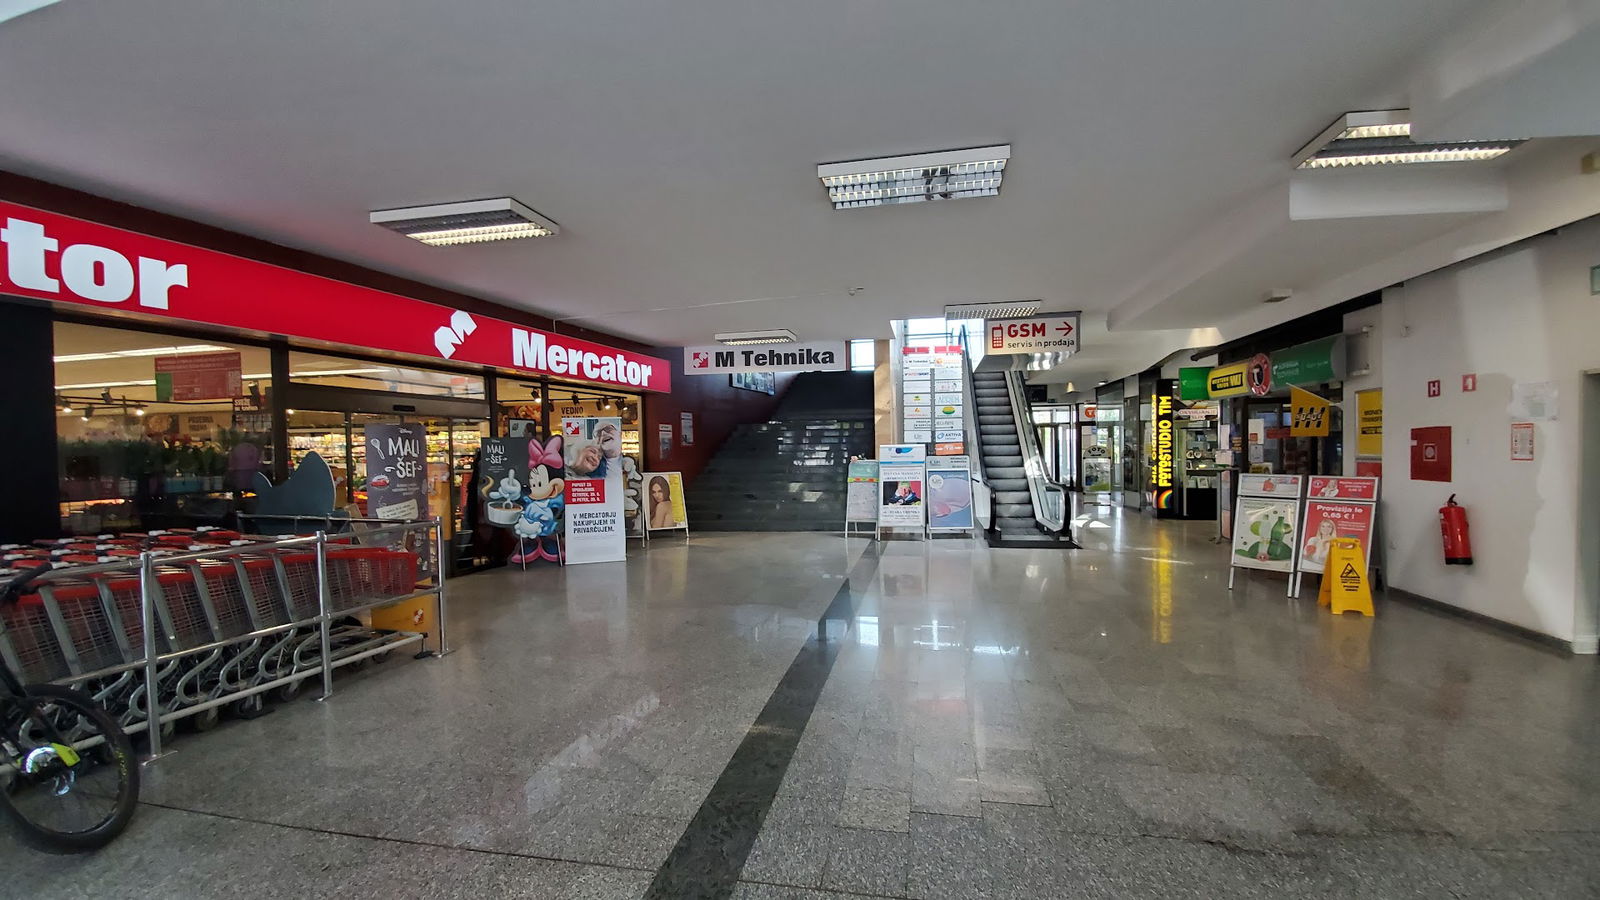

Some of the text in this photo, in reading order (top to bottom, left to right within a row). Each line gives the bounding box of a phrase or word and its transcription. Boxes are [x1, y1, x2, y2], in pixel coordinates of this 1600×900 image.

[1007, 323, 1046, 338] GSM
[1044, 339, 1075, 348] prodaja
[512, 327, 652, 387] Mercator
[715, 348, 835, 368] M Tehnika
[561, 406, 584, 415] VEDNO
[388, 436, 420, 457] MALI
[1158, 395, 1172, 487] FOTOSTUDIO TIM
[487, 444, 505, 454] MALI
[490, 454, 503, 464] ŠEF
[396, 457, 417, 478] ŠEF
[573, 525, 615, 534] PRIVARČUJEM.
